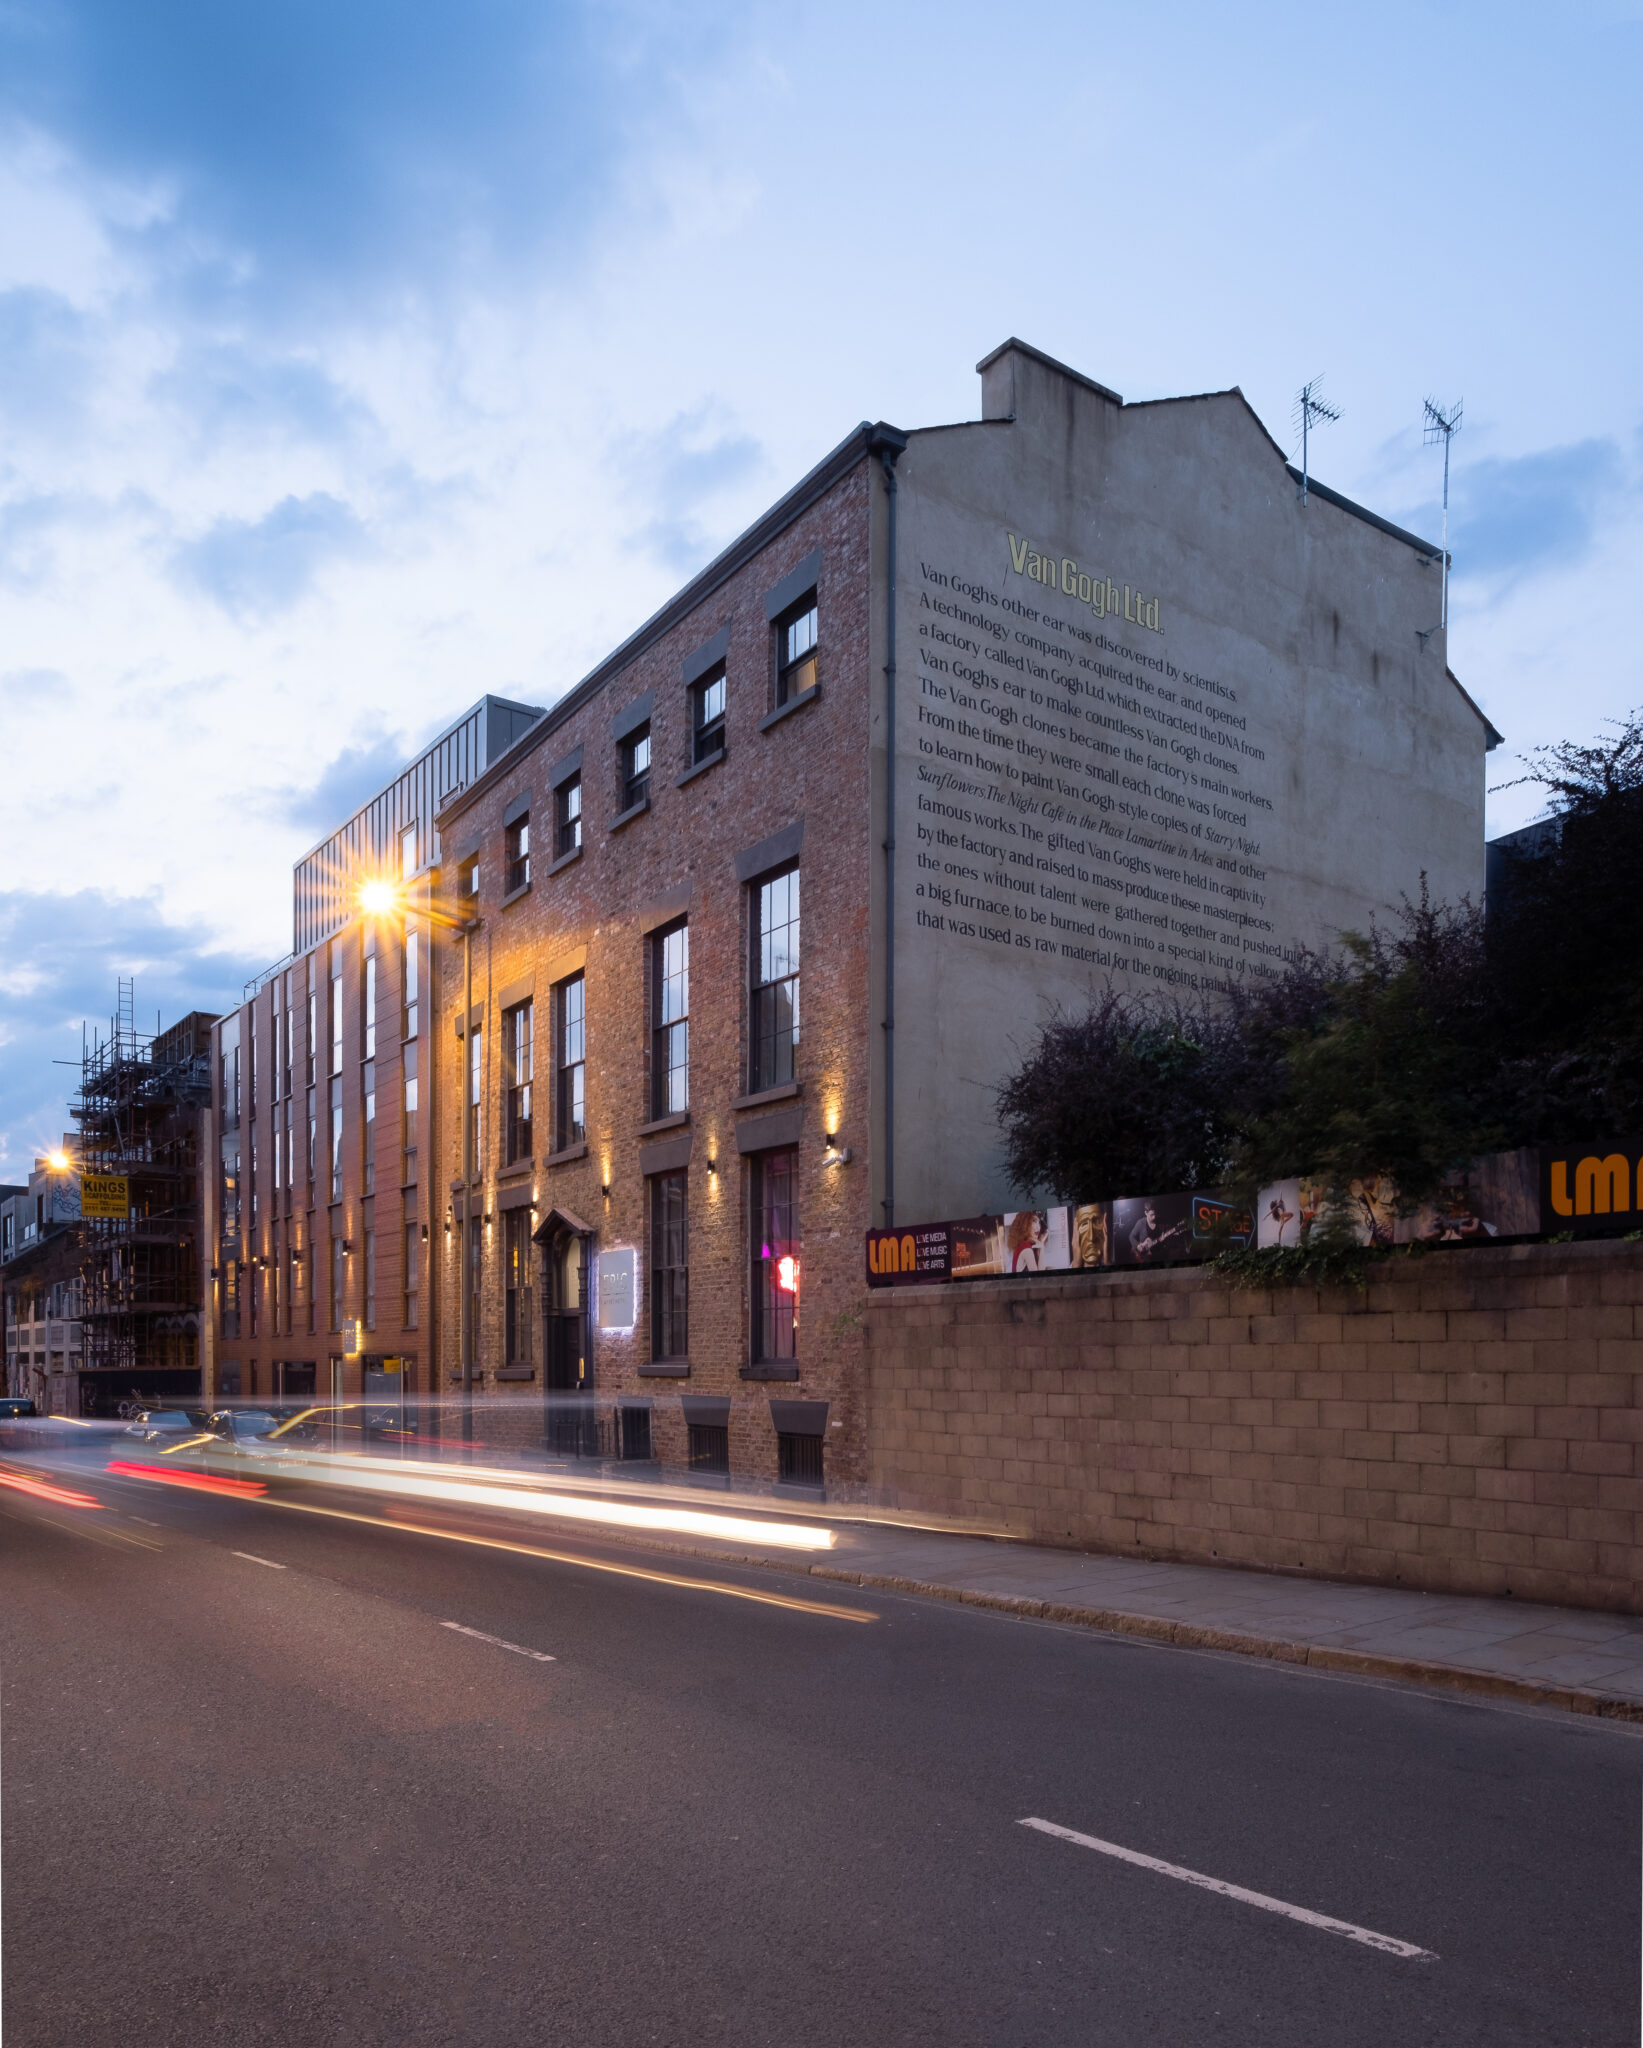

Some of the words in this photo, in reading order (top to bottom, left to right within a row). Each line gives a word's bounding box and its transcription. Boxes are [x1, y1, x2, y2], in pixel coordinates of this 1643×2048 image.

[920, 561, 948, 588] Van
[1001, 598, 1041, 623] other
[1042, 614, 1065, 633] ear
[1067, 624, 1092, 644] was
[1095, 634, 1164, 673] discovered
[1166, 661, 1181, 682] by
[1007, 533, 1056, 589] Van
[1061, 557, 1120, 619] Gogh
[1124, 584, 1165, 635] Ltd.
[918, 623, 929, 637] a
[931, 623, 981, 659] factory
[984, 647, 1025, 672] called
[1026, 658, 1049, 681] Van
[1050, 668, 1084, 696] Gogh
[1107, 692, 1141, 715] which
[1143, 705, 1198, 737] extracted
[1199, 725, 1217, 743] the
[1217, 731, 1240, 752] DNA
[1241, 740, 1265, 761] from
[919, 591, 931, 610] A
[933, 597, 1011, 642] technology
[1014, 631, 1076, 667] company
[1078, 656, 1133, 687] acquired
[1135, 675, 1155, 695] the
[1180, 696, 1203, 714] and
[1205, 706, 1247, 732] opened
[918, 675, 947, 700] The
[948, 686, 977, 711] Van
[980, 698, 1018, 726] Gogh
[1022, 713, 1067, 739] clones
[1069, 727, 1121, 758] became
[1124, 747, 1144, 766] the
[1200, 777, 1229, 796] main
[1230, 787, 1274, 812] workers.
[919, 647, 949, 673] Van
[1002, 681, 1027, 699] ear
[1029, 688, 1043, 705] to
[1046, 696, 1082, 719] make
[1085, 710, 1145, 741] countless
[1146, 728, 1168, 750] Van
[1170, 739, 1201, 764] Gogh
[1203, 751, 1240, 775] clones.
[918, 704, 955, 733] From
[957, 719, 980, 740] the
[982, 727, 1014, 751] time
[1016, 738, 1048, 765] they
[1050, 751, 1082, 773] were
[1121, 776, 1152, 797] each
[1154, 785, 1185, 808] clone
[1186, 797, 1210, 816] was
[1212, 803, 1247, 828] forced
[918, 736, 934, 754] to
[936, 740, 973, 766] learn
[975, 752, 1004, 775] how
[1005, 762, 1019, 780] to
[1021, 770, 1055, 791] paint
[1056, 778, 1080, 799] Van
[1150, 812, 1189, 834] copies
[1190, 823, 1202, 838] of
[1204, 826, 1238, 852] Starry
[917, 793, 972, 823] famous
[1019, 822, 1044, 843] The
[1047, 832, 1085, 855] gifted
[1153, 864, 1181, 882] were
[1183, 870, 1207, 890] held
[1209, 877, 1219, 894] in
[1220, 884, 1267, 910] captivity
[917, 822, 934, 847] by
[936, 828, 959, 848] the
[960, 833, 1007, 866] factory
[1008, 850, 1034, 868] and
[1036, 857, 1075, 879] raised
[1077, 866, 1089, 882] to
[1170, 892, 1201, 913] these
[986, 784, 1007, 804] The
[1007, 791, 1040, 815] Night
[1065, 810, 1078, 826] in
[1079, 814, 1097, 831] the
[1097, 819, 1125, 840] Place
[1125, 827, 1177, 856] Lamartine
[1177, 844, 1188, 859] in
[1189, 847, 1214, 866] Arles
[1215, 857, 1237, 873] and
[1239, 863, 1268, 882] other
[915, 883, 925, 897] a
[928, 882, 953, 908] big
[954, 888, 1012, 918] furnace,
[1014, 904, 1028, 920] to
[1030, 906, 1047, 925] be
[1050, 911, 1095, 937] burned
[1098, 925, 1131, 945] down
[1133, 932, 1155, 951] into
[1157, 942, 1165, 953] a
[1167, 944, 1206, 966] special
[1208, 950, 1234, 970] kind
[1235, 958, 1246, 974] of
[1248, 962, 1282, 980] yellow
[916, 909, 945, 931] that
[948, 919, 976, 937] was
[978, 925, 1011, 945] used
[1014, 934, 1031, 949] as
[1034, 938, 1058, 954] raw
[1061, 943, 1111, 967] material
[1112, 952, 1130, 970] for
[1132, 957, 1151, 976] the
[1152, 965, 1199, 991] ongoing
[917, 852, 941, 871] the
[944, 862, 979, 881] ones
[983, 870, 1036, 896] without
[1040, 883, 1077, 906] talent
[1081, 896, 1110, 914] were
[1114, 905, 1169, 929] gathered
[1171, 918, 1218, 942] together
[1219, 933, 1240, 948] and
[1243, 938, 1282, 958] pushed
[84, 1181, 126, 1193] KINGS
[84, 1192, 126, 1201] SCAFFOLDING
[1199, 1206, 1251, 1233] STGE
[869, 1234, 916, 1274] LMA
[916, 1233, 929, 1244] LOVE
[929, 1231, 947, 1242] MEDIA
[916, 1246, 930, 1257] LOVE
[930, 1245, 948, 1256] MUSIC
[917, 1260, 930, 1271] LOVE
[930, 1259, 945, 1270] ARTS
